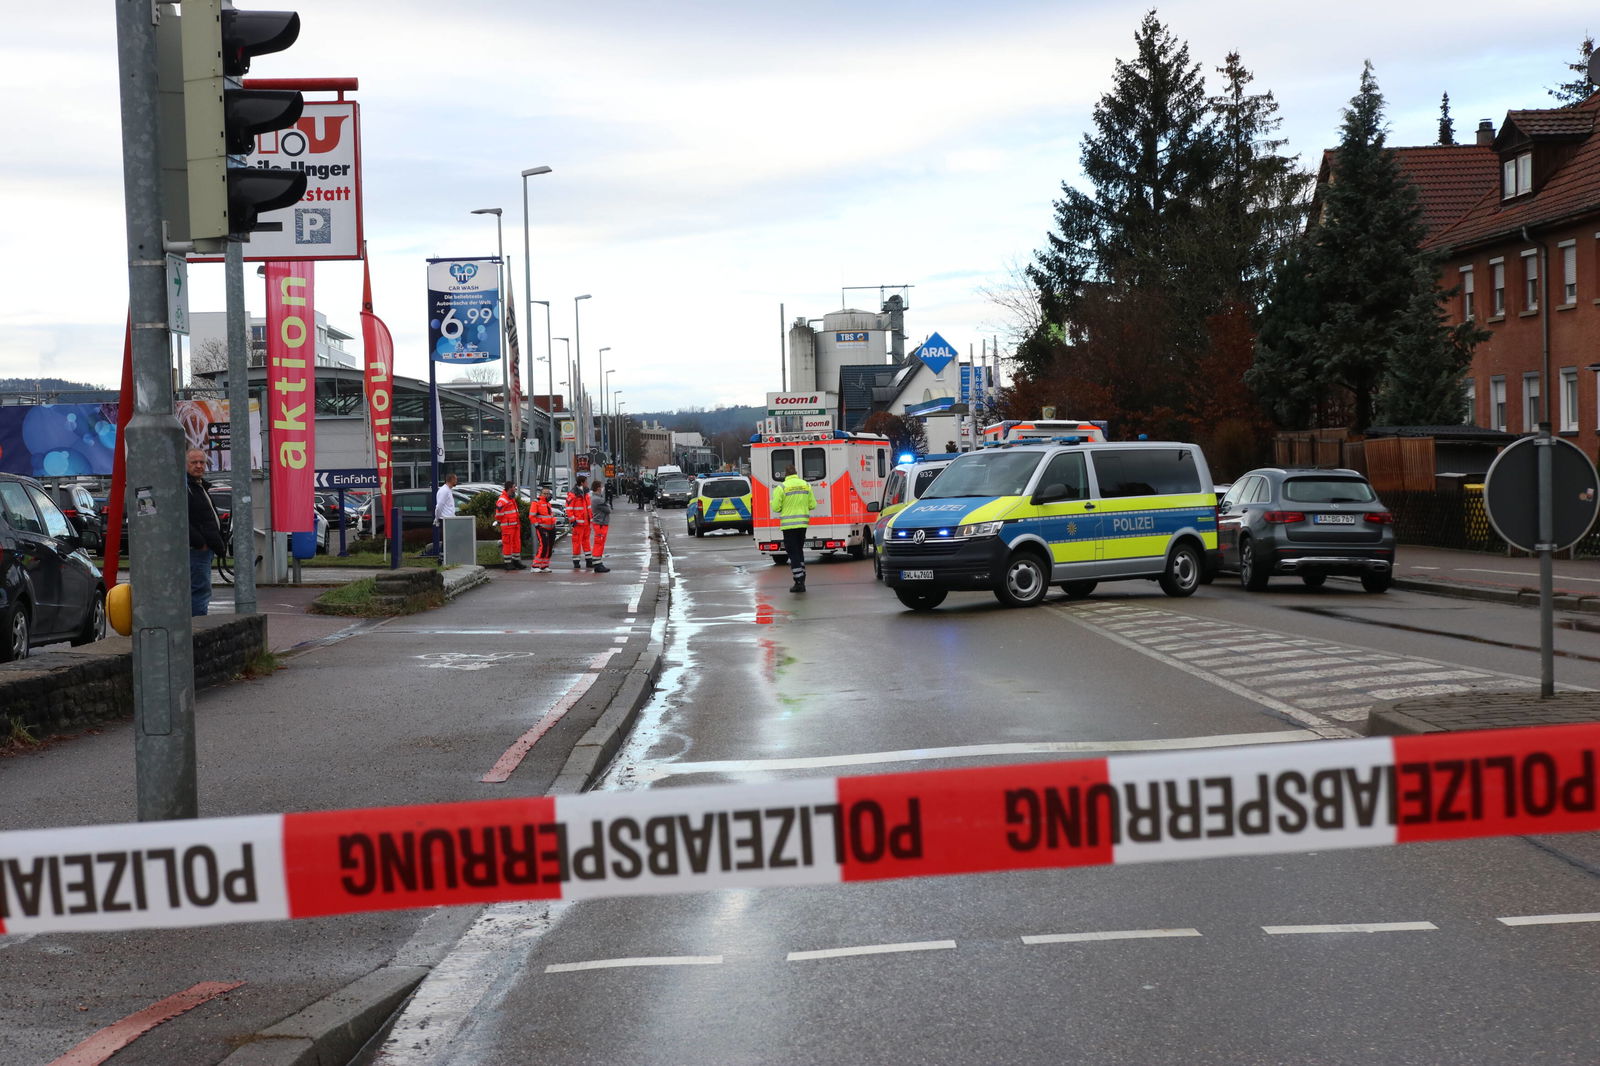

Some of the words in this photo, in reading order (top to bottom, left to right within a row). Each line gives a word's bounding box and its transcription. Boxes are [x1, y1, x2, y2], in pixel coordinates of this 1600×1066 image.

[300, 187, 351, 201] statt
[441, 308, 492, 339] 6.99
[840, 333, 854, 341] TBS
[920, 346, 953, 358] ARAL
[272, 276, 307, 470] aktion
[775, 396, 809, 405] toom
[333, 474, 377, 485] Einfahrt
[919, 470, 933, 478] 932
[912, 504, 967, 513] POLIZEI
[1113, 516, 1155, 532] POLIZEI
